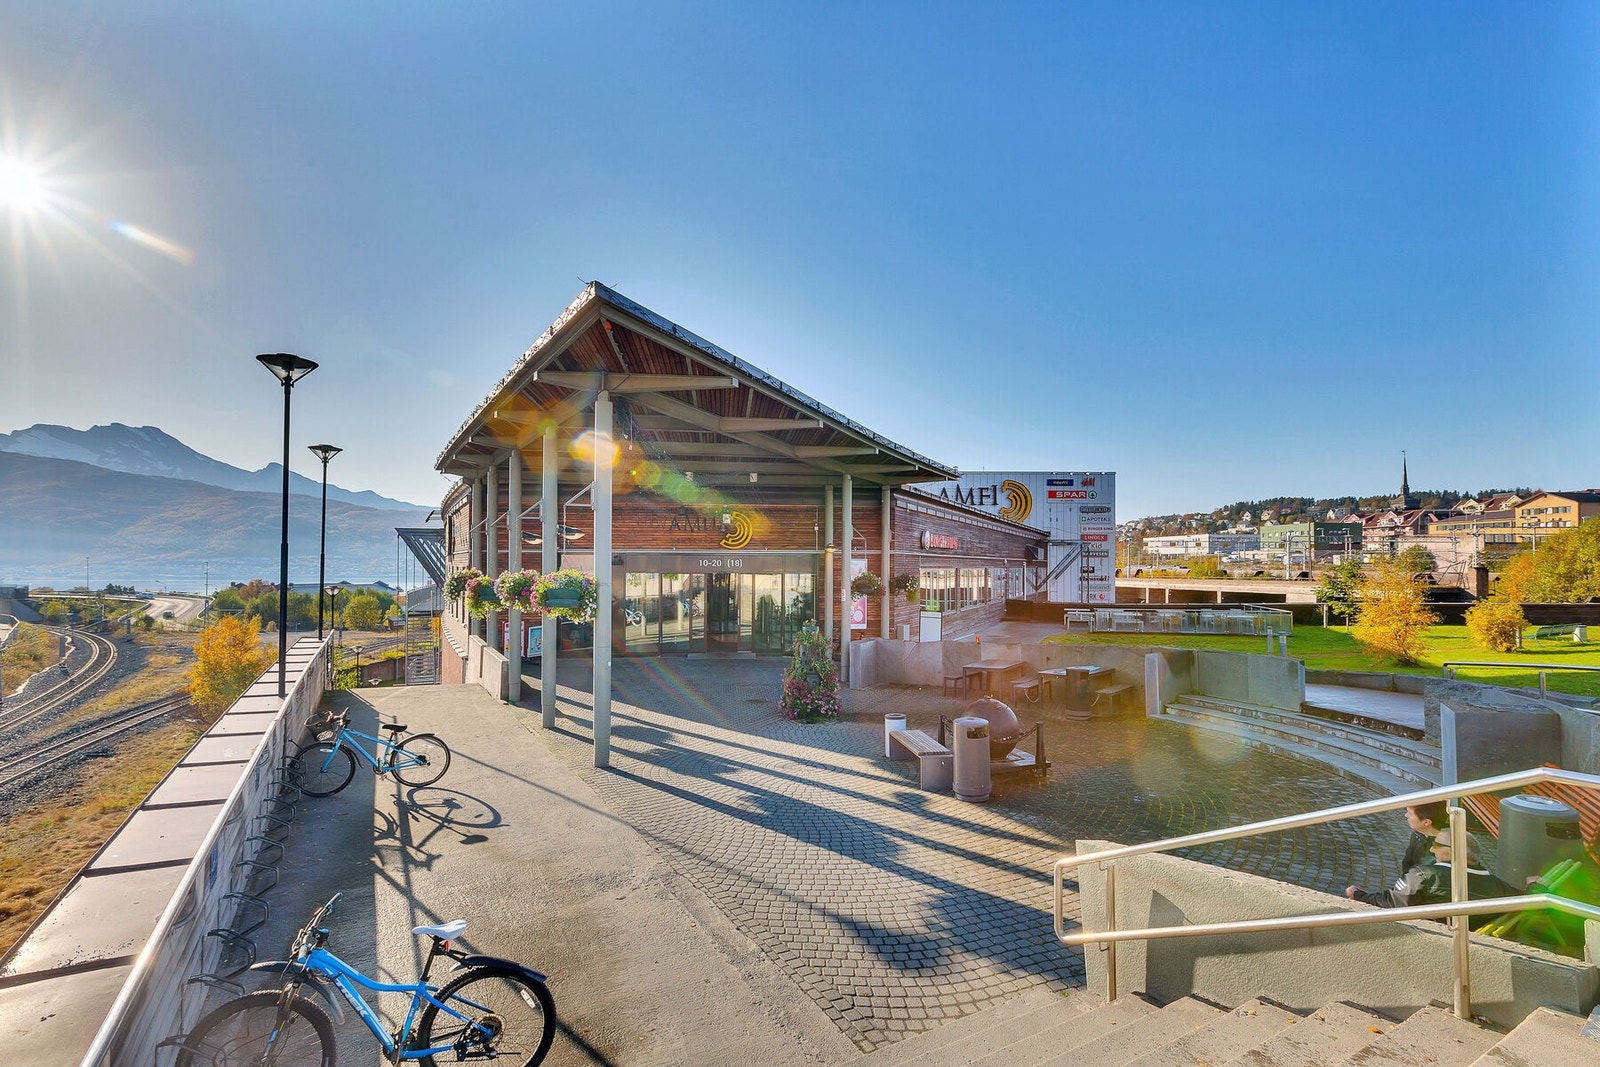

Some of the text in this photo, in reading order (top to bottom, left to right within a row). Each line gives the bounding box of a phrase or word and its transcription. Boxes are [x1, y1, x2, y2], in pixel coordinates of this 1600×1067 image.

[940, 483, 999, 506] AMFI
[698, 559, 743, 568] 10-20 (18)
[335, 977, 370, 1018] TREK
